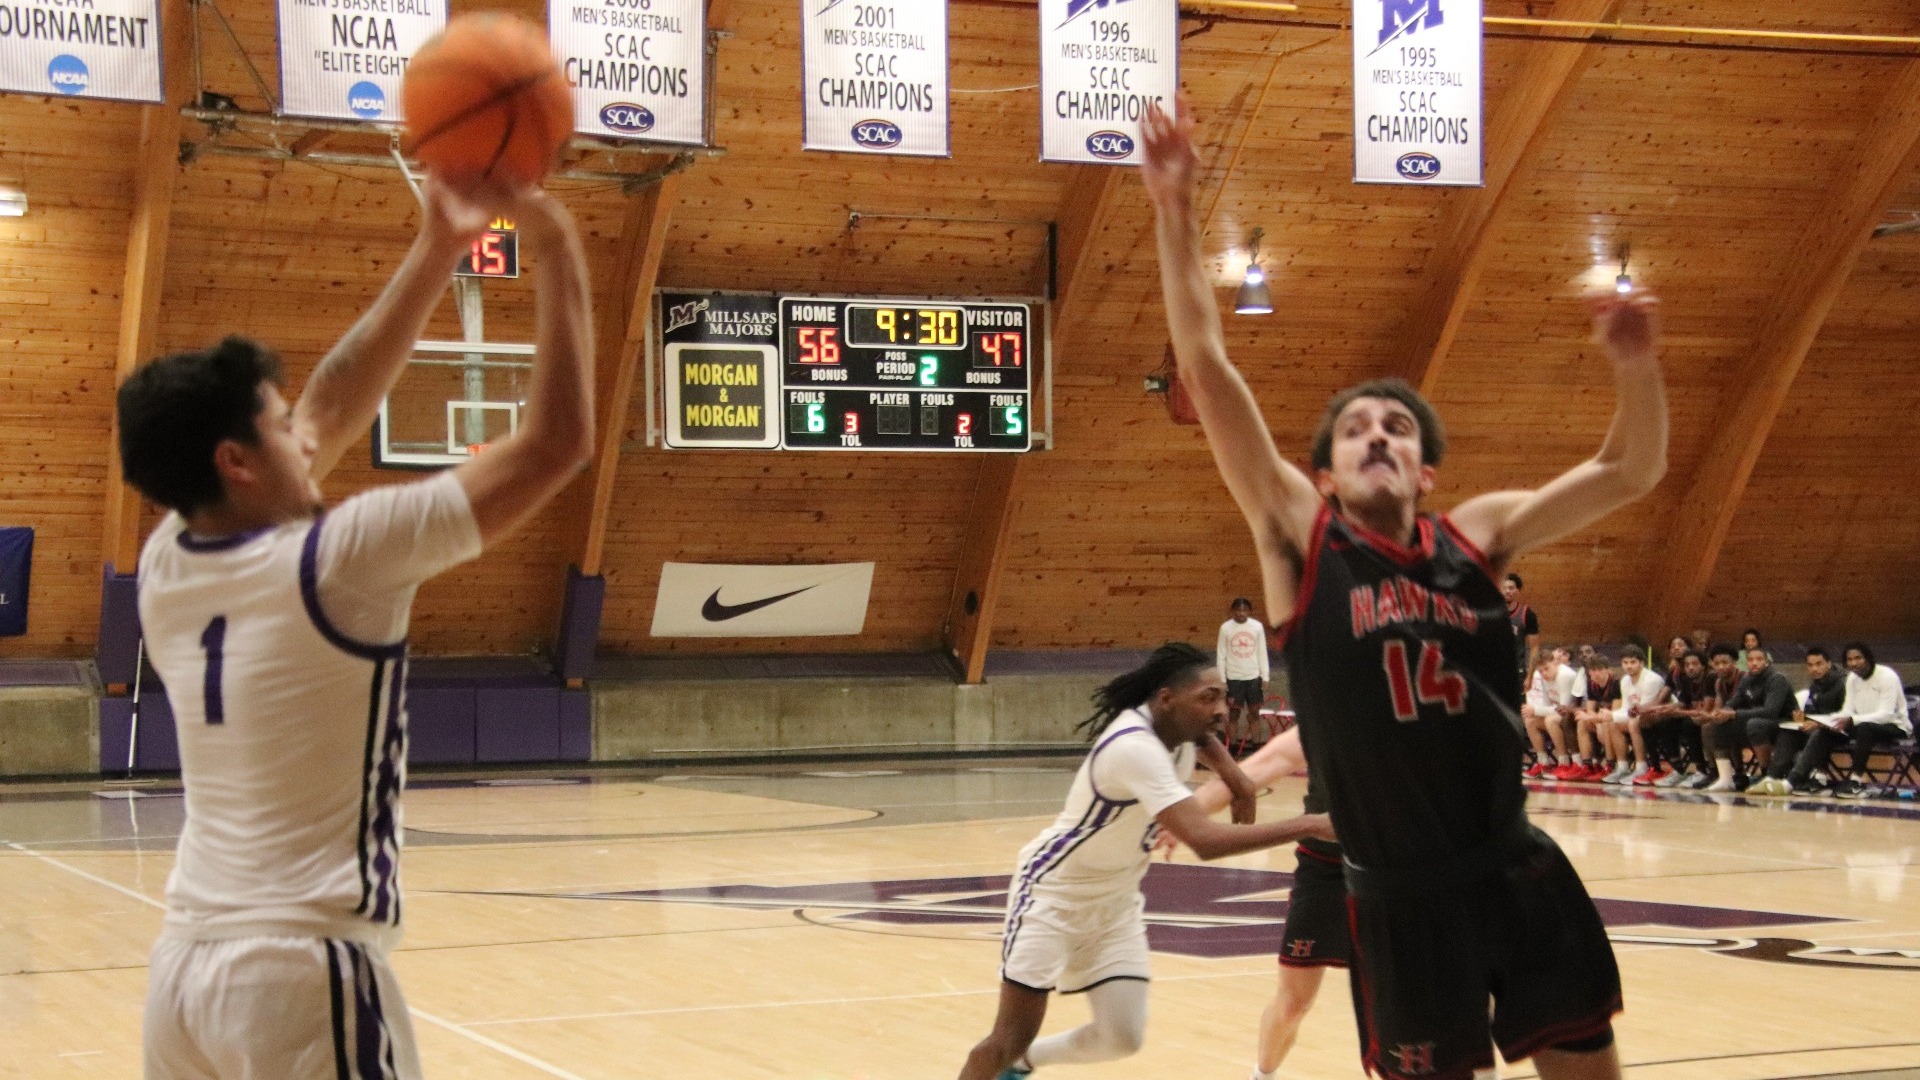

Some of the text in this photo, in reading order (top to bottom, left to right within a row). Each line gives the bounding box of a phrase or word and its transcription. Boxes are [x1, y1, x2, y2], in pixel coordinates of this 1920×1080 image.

[572, 7, 683, 34] MEN'S BASKETBALL
[854, 5, 896, 29] 2001
[331, 14, 398, 51] NCAA
[824, 29, 925, 51] MEN'S BASKETBALL
[1091, 20, 1130, 43] 1996
[604, 32, 652, 61] SCAC
[1061, 43, 1158, 64] MEN'S BASKETBALL
[1400, 46, 1437, 68] 1995
[855, 53, 898, 79] SCAC
[52, 71, 89, 86] NCAA
[564, 57, 688, 98] CHAMPIONS
[1089, 66, 1130, 91] SCAC
[1372, 69, 1463, 87] MEN'S BASKETBALL
[352, 98, 385, 111] NCAA
[819, 78, 933, 112] CHAMPIONS
[1399, 91, 1438, 114] SCAC
[606, 109, 648, 128] SCAC
[857, 126, 896, 143] SCAC
[1368, 115, 1468, 145] CHAMPIONS
[1092, 138, 1128, 153] SCAC
[1401, 159, 1437, 175] SCAC
[471, 234, 506, 274] 15
[704, 310, 777, 325] MILLSAPS
[791, 304, 837, 322] HOME
[967, 310, 1023, 327] VISITOR
[709, 323, 773, 337] MAJORS
[876, 309, 958, 345] 9:30
[798, 327, 840, 364] 56
[885, 351, 907, 361] POSS
[981, 333, 1022, 367] 47
[685, 363, 758, 386] MORGAN
[811, 369, 848, 382] BONUS
[876, 362, 916, 375] PERIOD
[920, 355, 938, 385] 2
[966, 371, 1001, 384] BONUS
[719, 387, 729, 403] &
[790, 391, 826, 404] FOULS
[869, 393, 910, 405] PLAYER
[920, 394, 955, 406] FOULS
[989, 395, 1023, 407] FOULS
[686, 404, 759, 427] MORGAN
[807, 406, 825, 432] 6
[845, 412, 858, 433] 3
[958, 414, 970, 434] 2
[1006, 407, 1022, 434] 5
[840, 435, 862, 447] TOL
[953, 436, 975, 448] TOL
[200, 615, 226, 725] 1
[1382, 639, 1468, 722] 14
